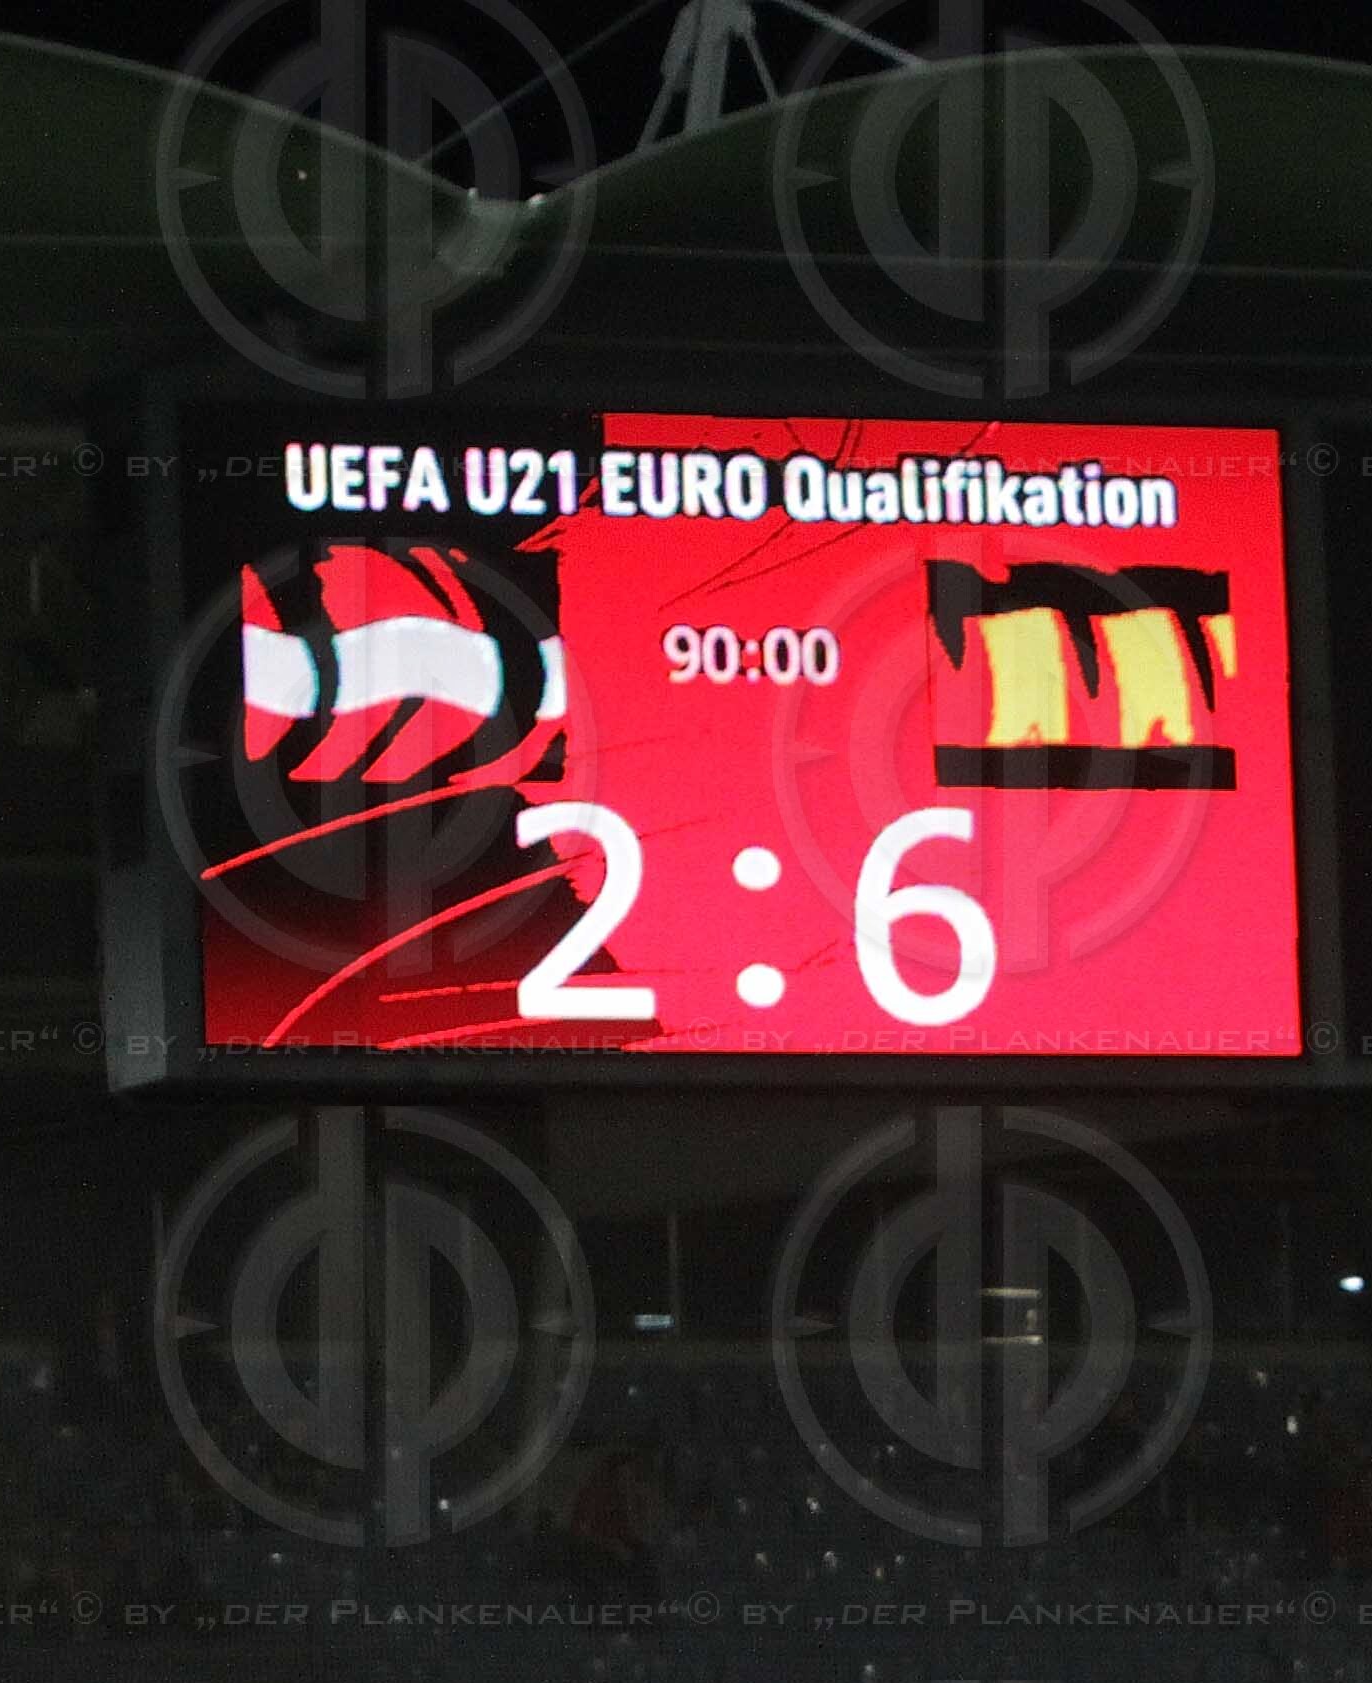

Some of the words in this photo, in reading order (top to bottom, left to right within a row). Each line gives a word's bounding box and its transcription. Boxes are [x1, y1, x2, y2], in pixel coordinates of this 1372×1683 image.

[284, 443, 450, 513] UEFA
[465, 446, 580, 518] U21
[601, 451, 767, 521] EURO
[784, 453, 1176, 529] Qualifikation
[661, 625, 842, 687] 90:00
[515, 802, 658, 1022] 2
[853, 806, 999, 1028] 6
